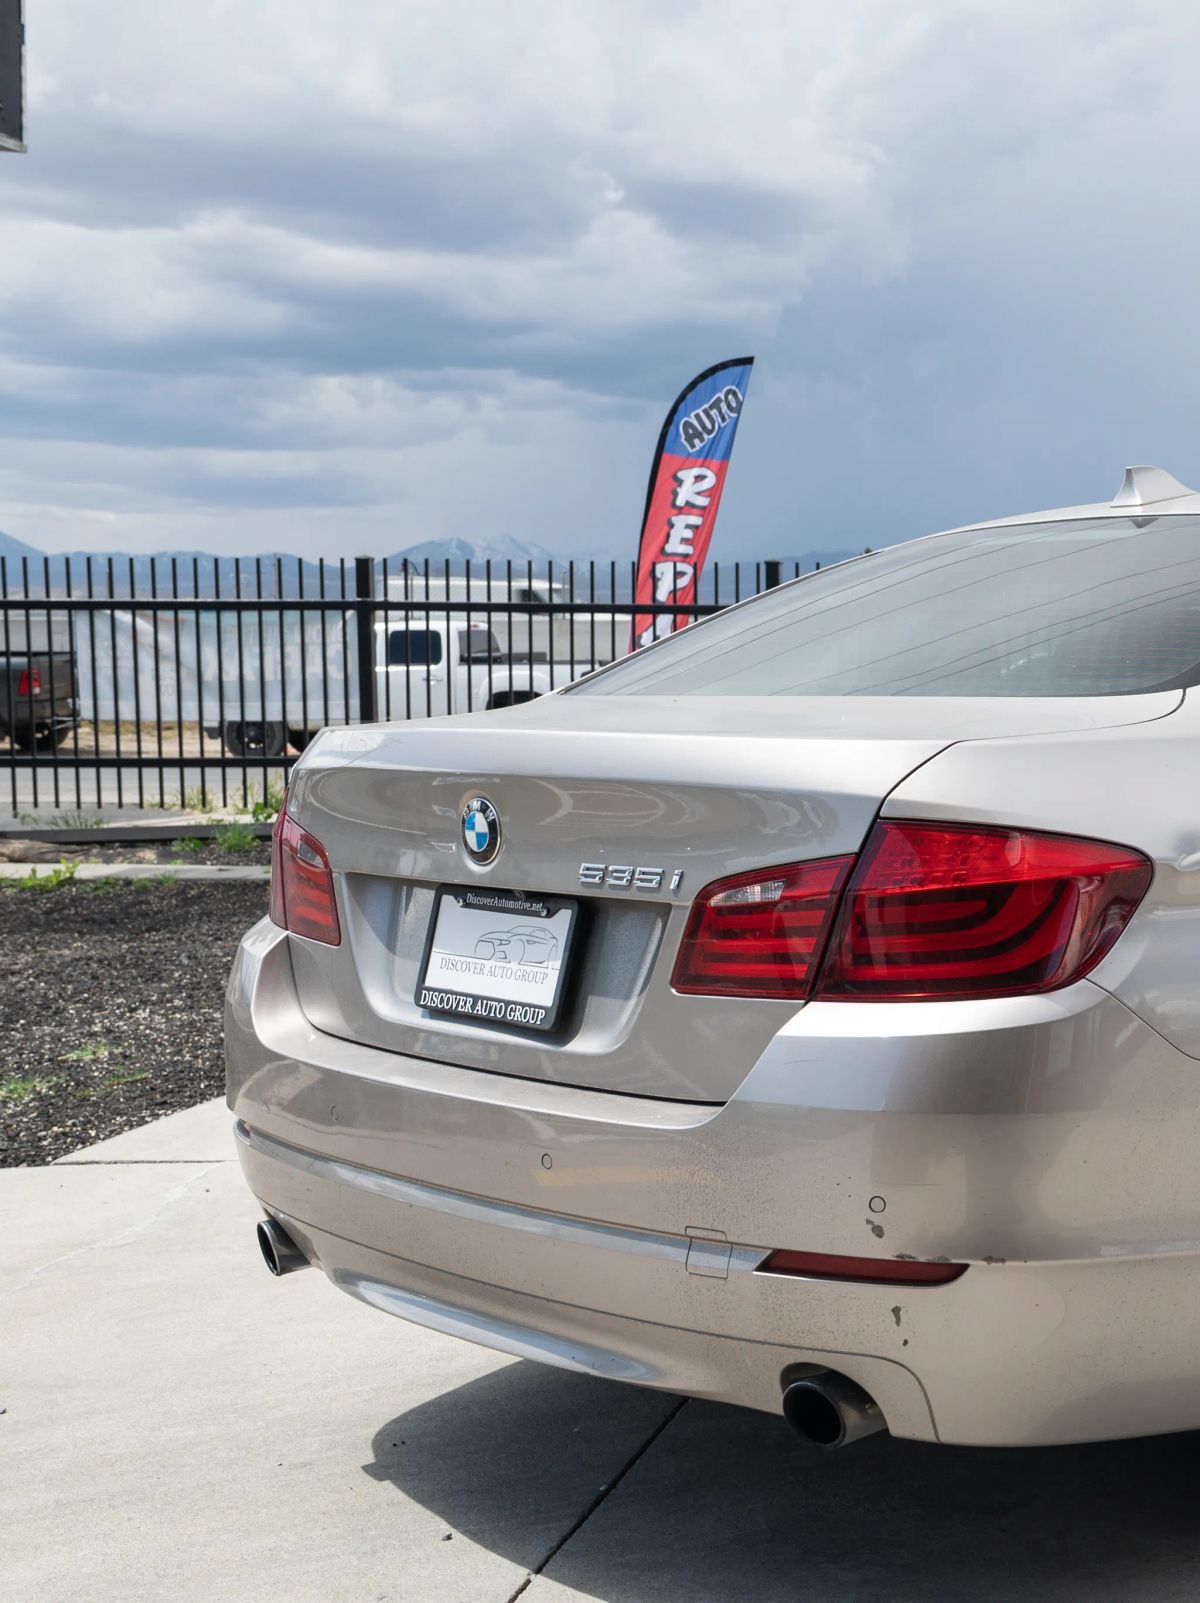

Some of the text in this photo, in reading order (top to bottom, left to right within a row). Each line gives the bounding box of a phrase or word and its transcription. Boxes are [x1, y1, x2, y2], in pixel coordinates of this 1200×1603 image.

[680, 386, 743, 452] AUTO
[466, 892, 544, 913] DiscoverAutomotive.net
[440, 957, 548, 985] DISCOVER AUTO GROUP
[419, 989, 546, 1025] DISCOVER AUTO GROUP
